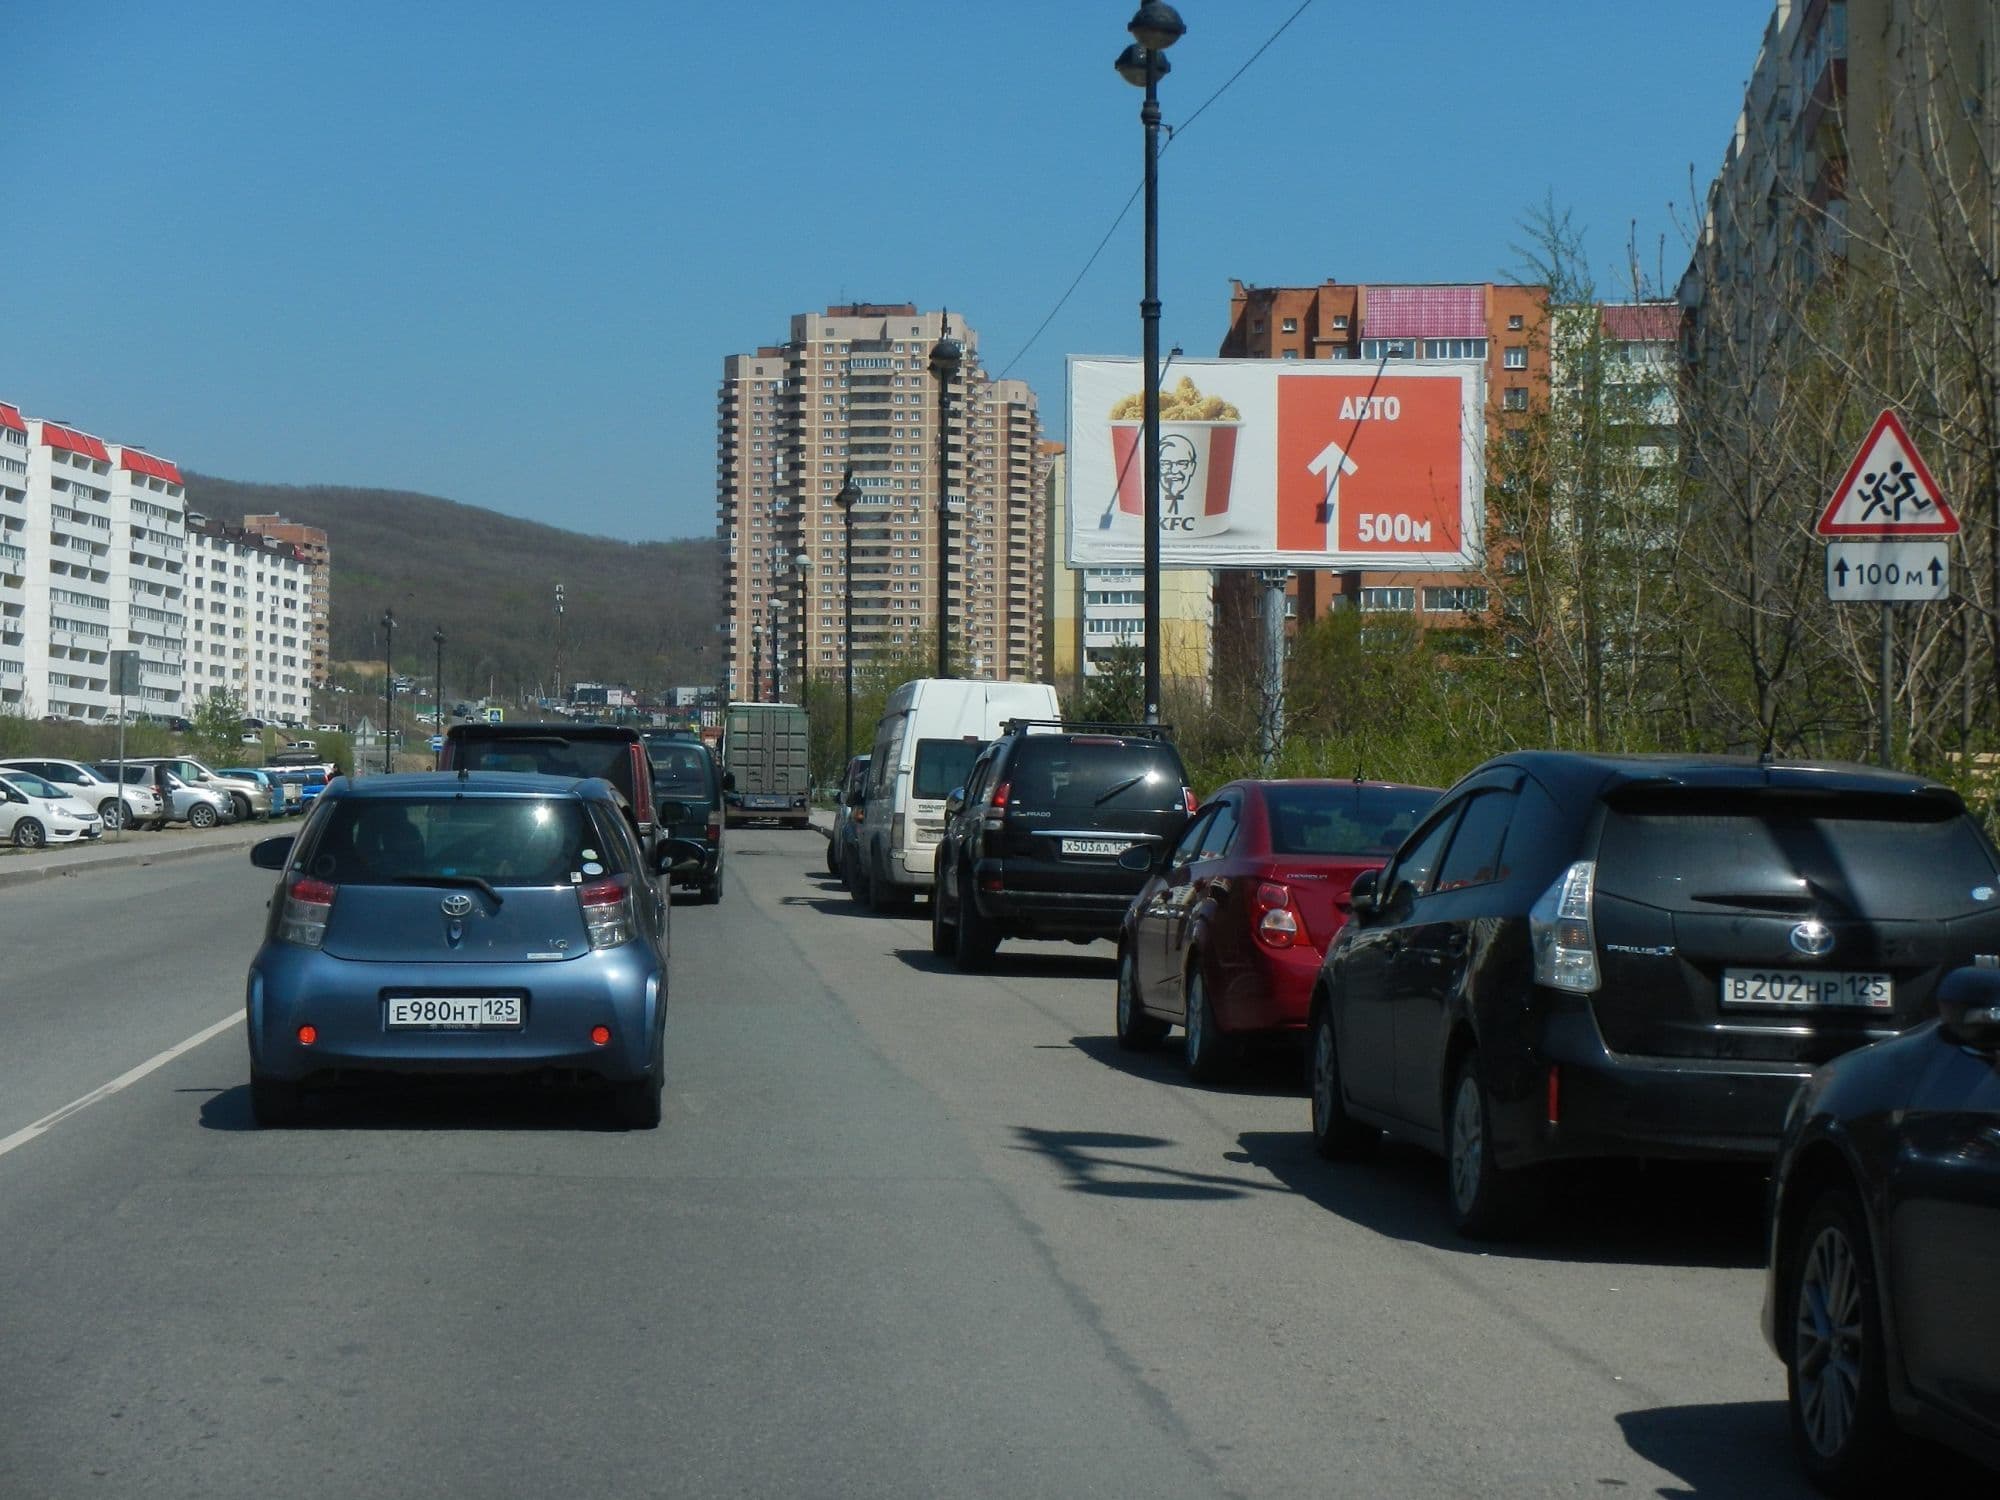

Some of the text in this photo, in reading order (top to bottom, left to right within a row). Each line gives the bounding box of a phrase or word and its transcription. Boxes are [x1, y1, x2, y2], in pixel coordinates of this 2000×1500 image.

[1339, 396, 1400, 421] АВТО
[1856, 563, 1900, 585] 100
[1846, 975, 1884, 997] 125
[484, 1000, 515, 1015] 125
